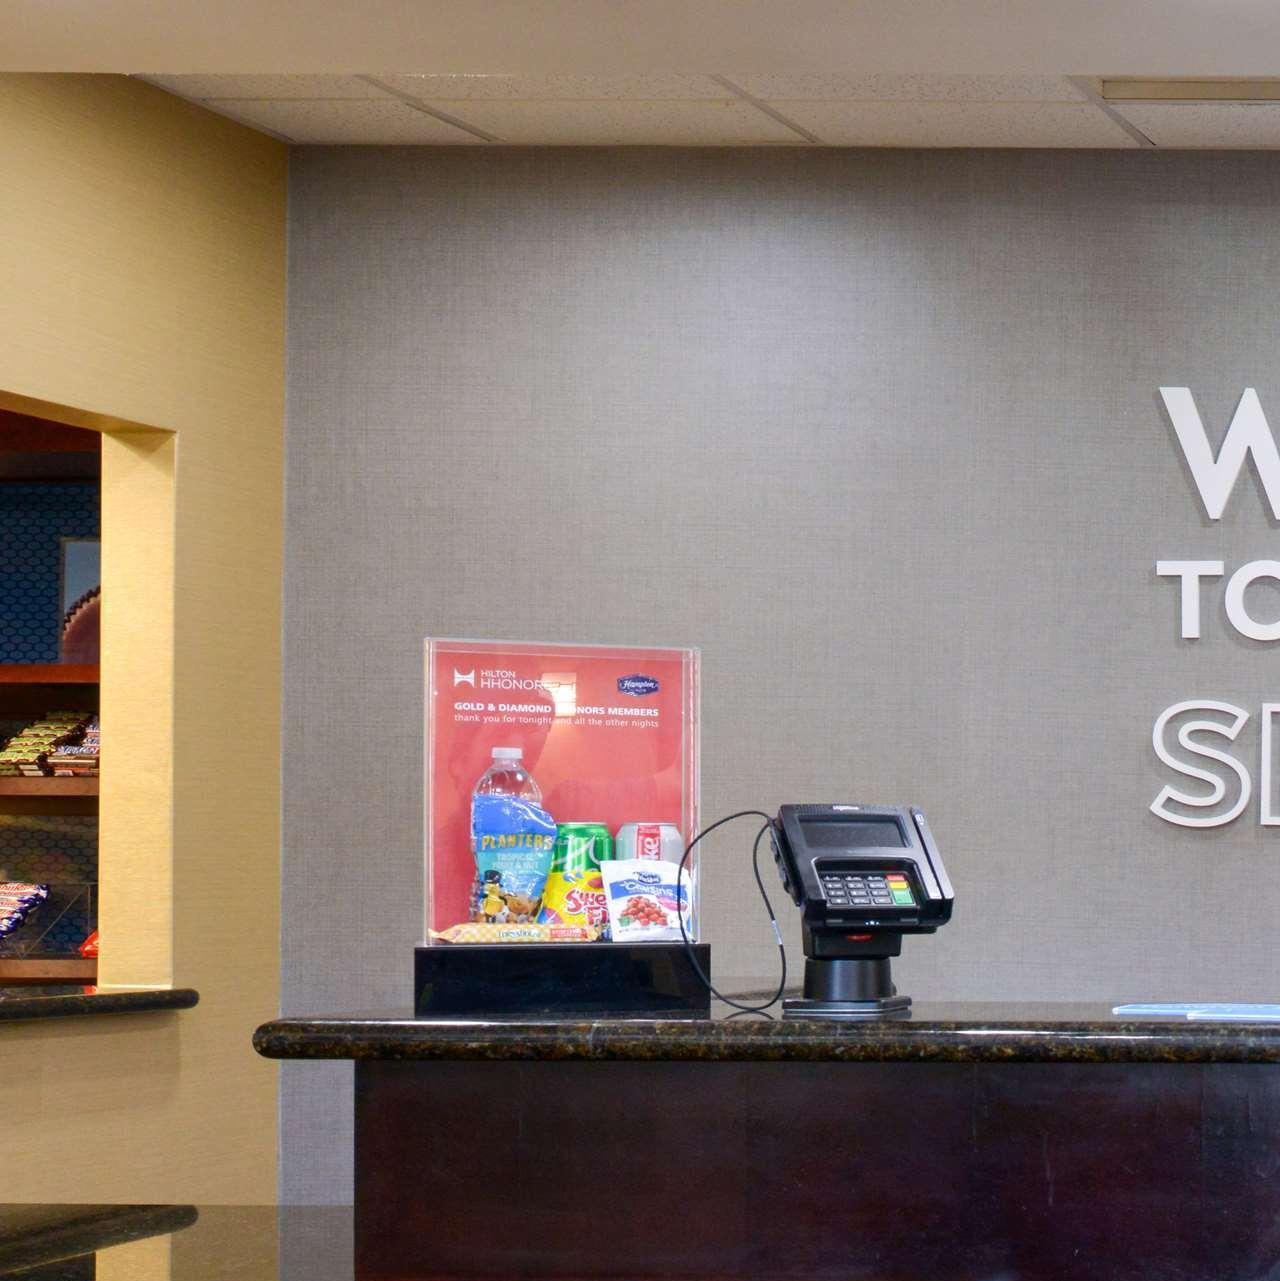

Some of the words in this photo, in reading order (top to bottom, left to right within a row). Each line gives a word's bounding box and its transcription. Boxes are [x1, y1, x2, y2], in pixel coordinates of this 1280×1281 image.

[480, 669, 516, 678] HILTON
[480, 677, 550, 690] HHONOR
[622, 679, 656, 688] Hampton
[454, 702, 485, 711] GOLD
[487, 702, 496, 712] &
[498, 703, 552, 713] DIAMOND
[607, 706, 659, 717] MEMBERS
[454, 713, 481, 722] thank
[483, 716, 500, 724] you
[503, 714, 516, 723] for
[518, 716, 552, 726] tonight
[574, 717, 585, 725] all
[587, 717, 602, 725] the
[604, 718, 628, 727] other
[631, 718, 659, 728] nights
[481, 833, 554, 850] PLANTERS
